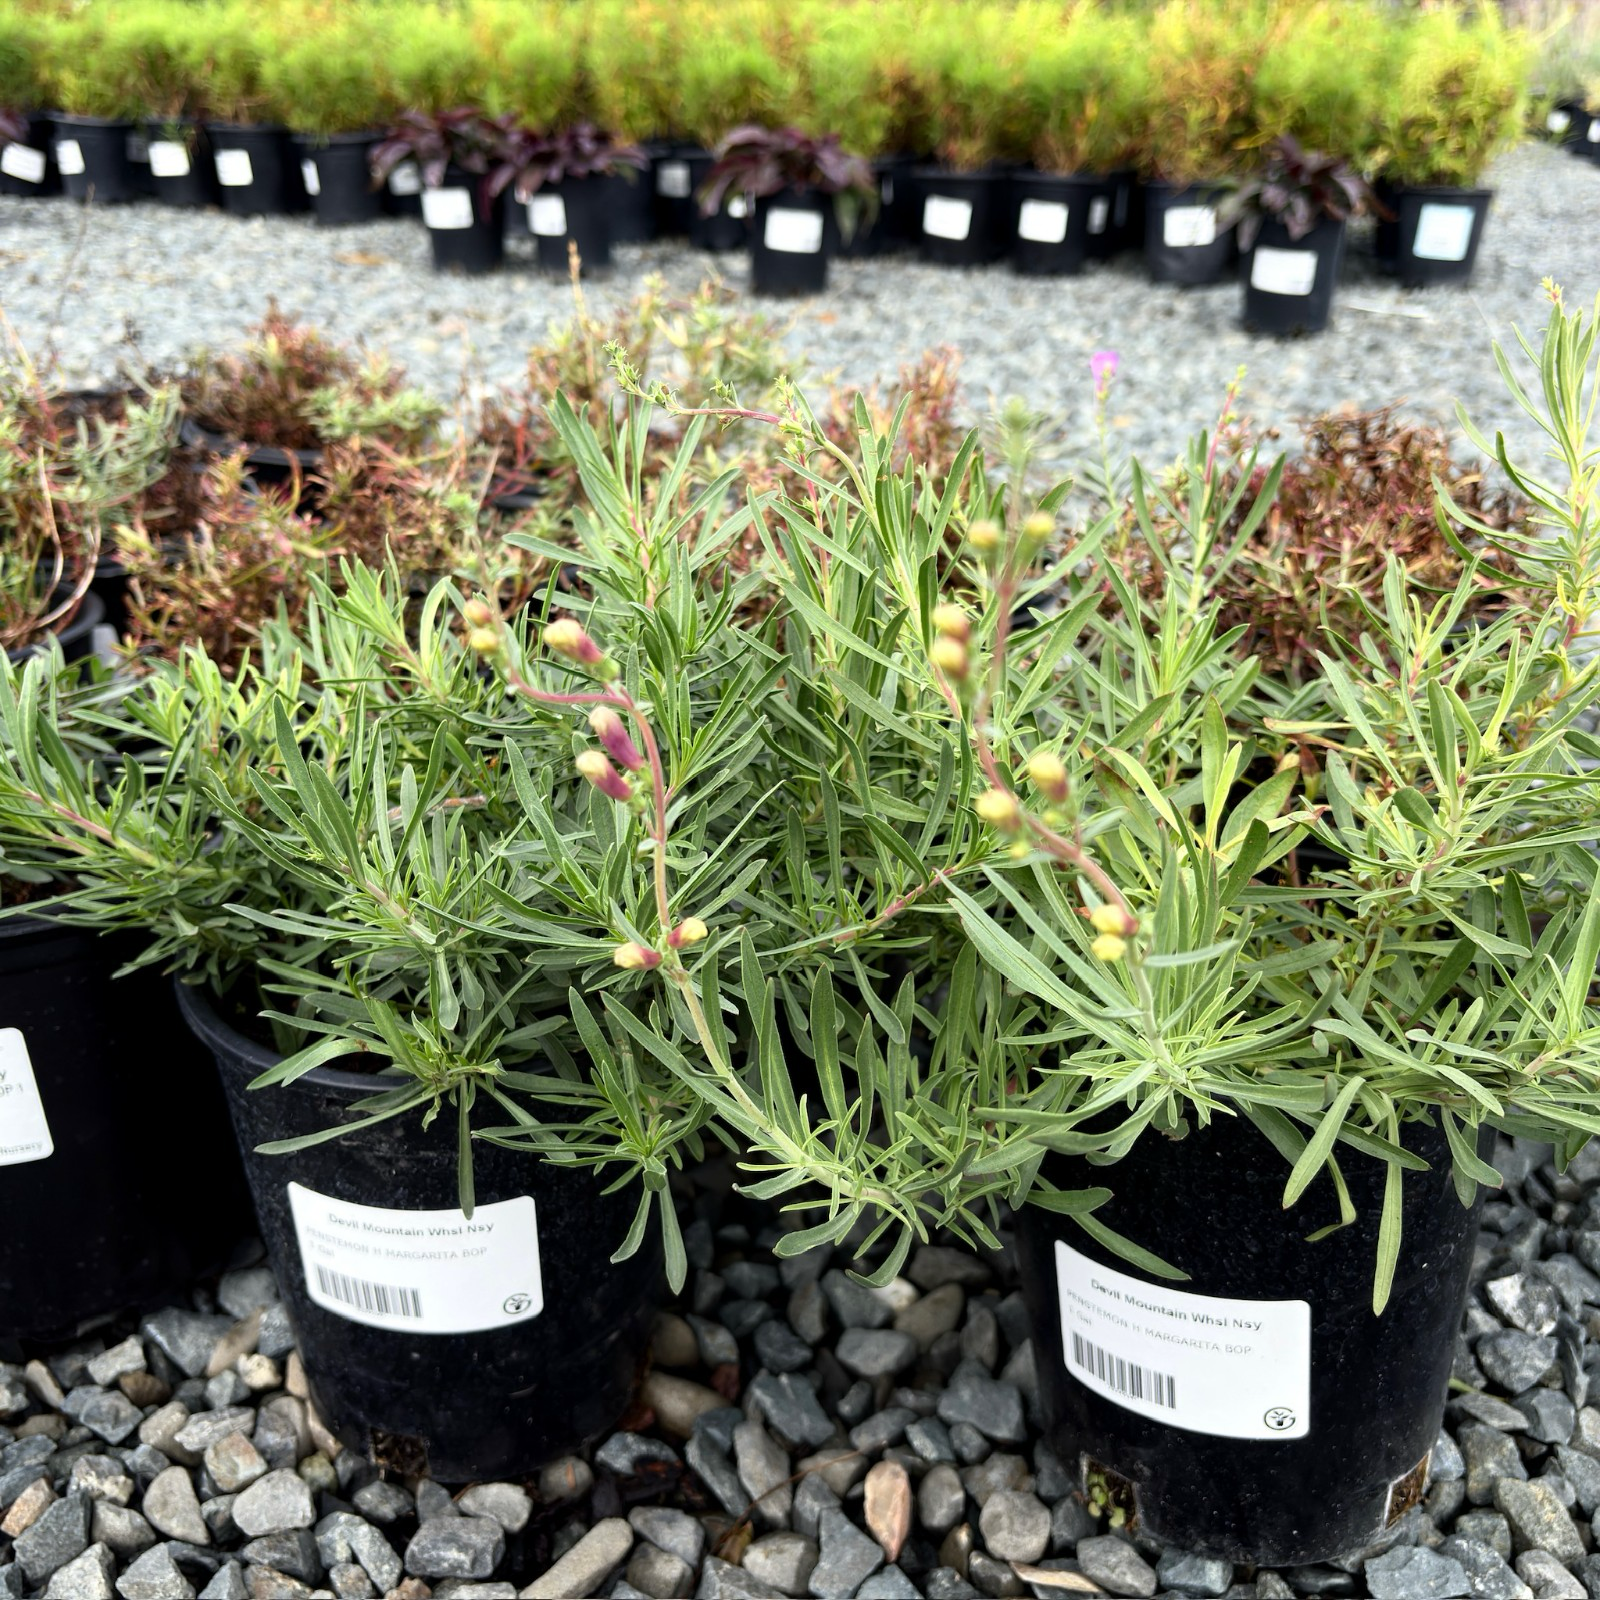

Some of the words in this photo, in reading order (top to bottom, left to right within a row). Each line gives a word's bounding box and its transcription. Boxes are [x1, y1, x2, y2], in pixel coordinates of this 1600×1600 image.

[328, 1213, 359, 1229] Devil
[363, 1222, 424, 1236] Mountain
[428, 1226, 463, 1236] Whsl
[467, 1222, 494, 1233] Nsy
[386, 1248, 458, 1260] MARGARITA
[462, 1246, 487, 1258] BOP
[1091, 1278, 1120, 1300] Devil
[1124, 1294, 1187, 1320] Mountain
[1191, 1312, 1228, 1327] Whsl
[1233, 1318, 1262, 1331] Nsy
[1145, 1327, 1220, 1351] MARGARITA
[1225, 1343, 1252, 1355] BOP
